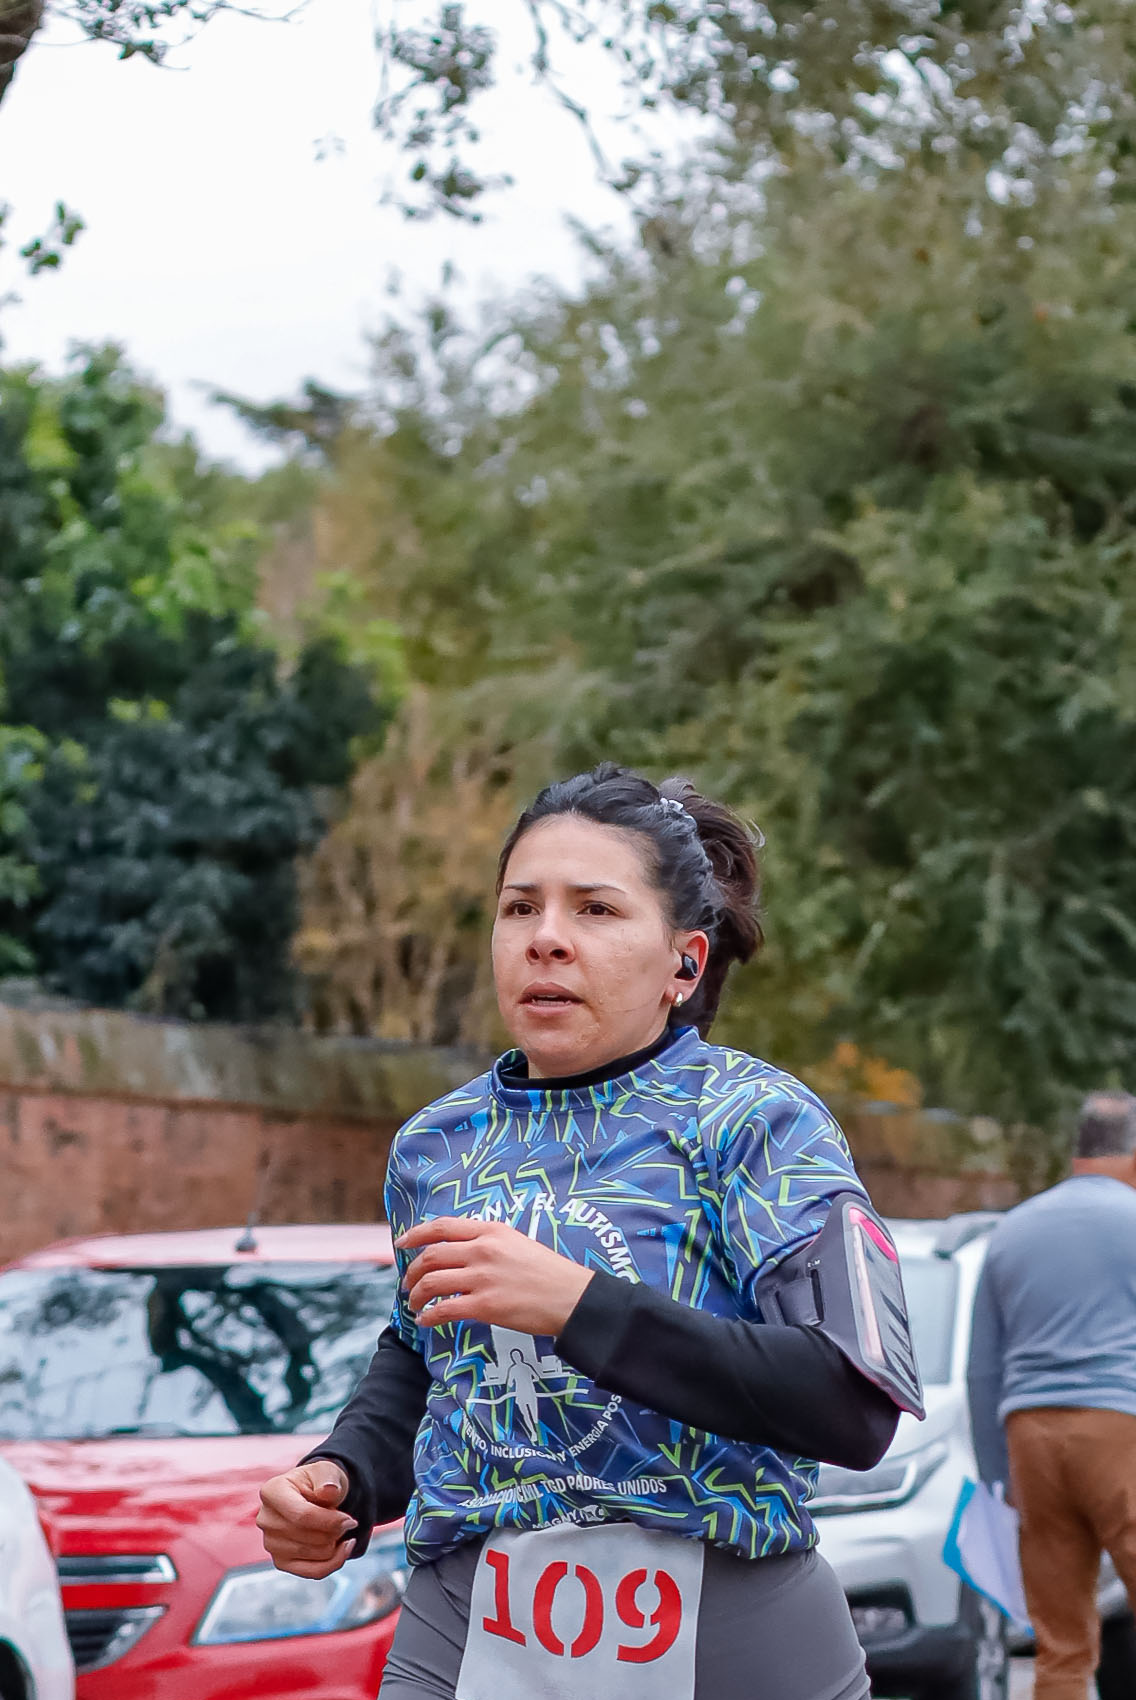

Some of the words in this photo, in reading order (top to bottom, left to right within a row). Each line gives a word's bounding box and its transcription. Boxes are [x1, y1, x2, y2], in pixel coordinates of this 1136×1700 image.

[509, 1193, 527, 1213] X
[532, 1192, 557, 1211] EL
[541, 1479, 566, 1494] TGD
[618, 1479, 668, 1495] UNIDOS
[483, 1549, 682, 1663] 109
